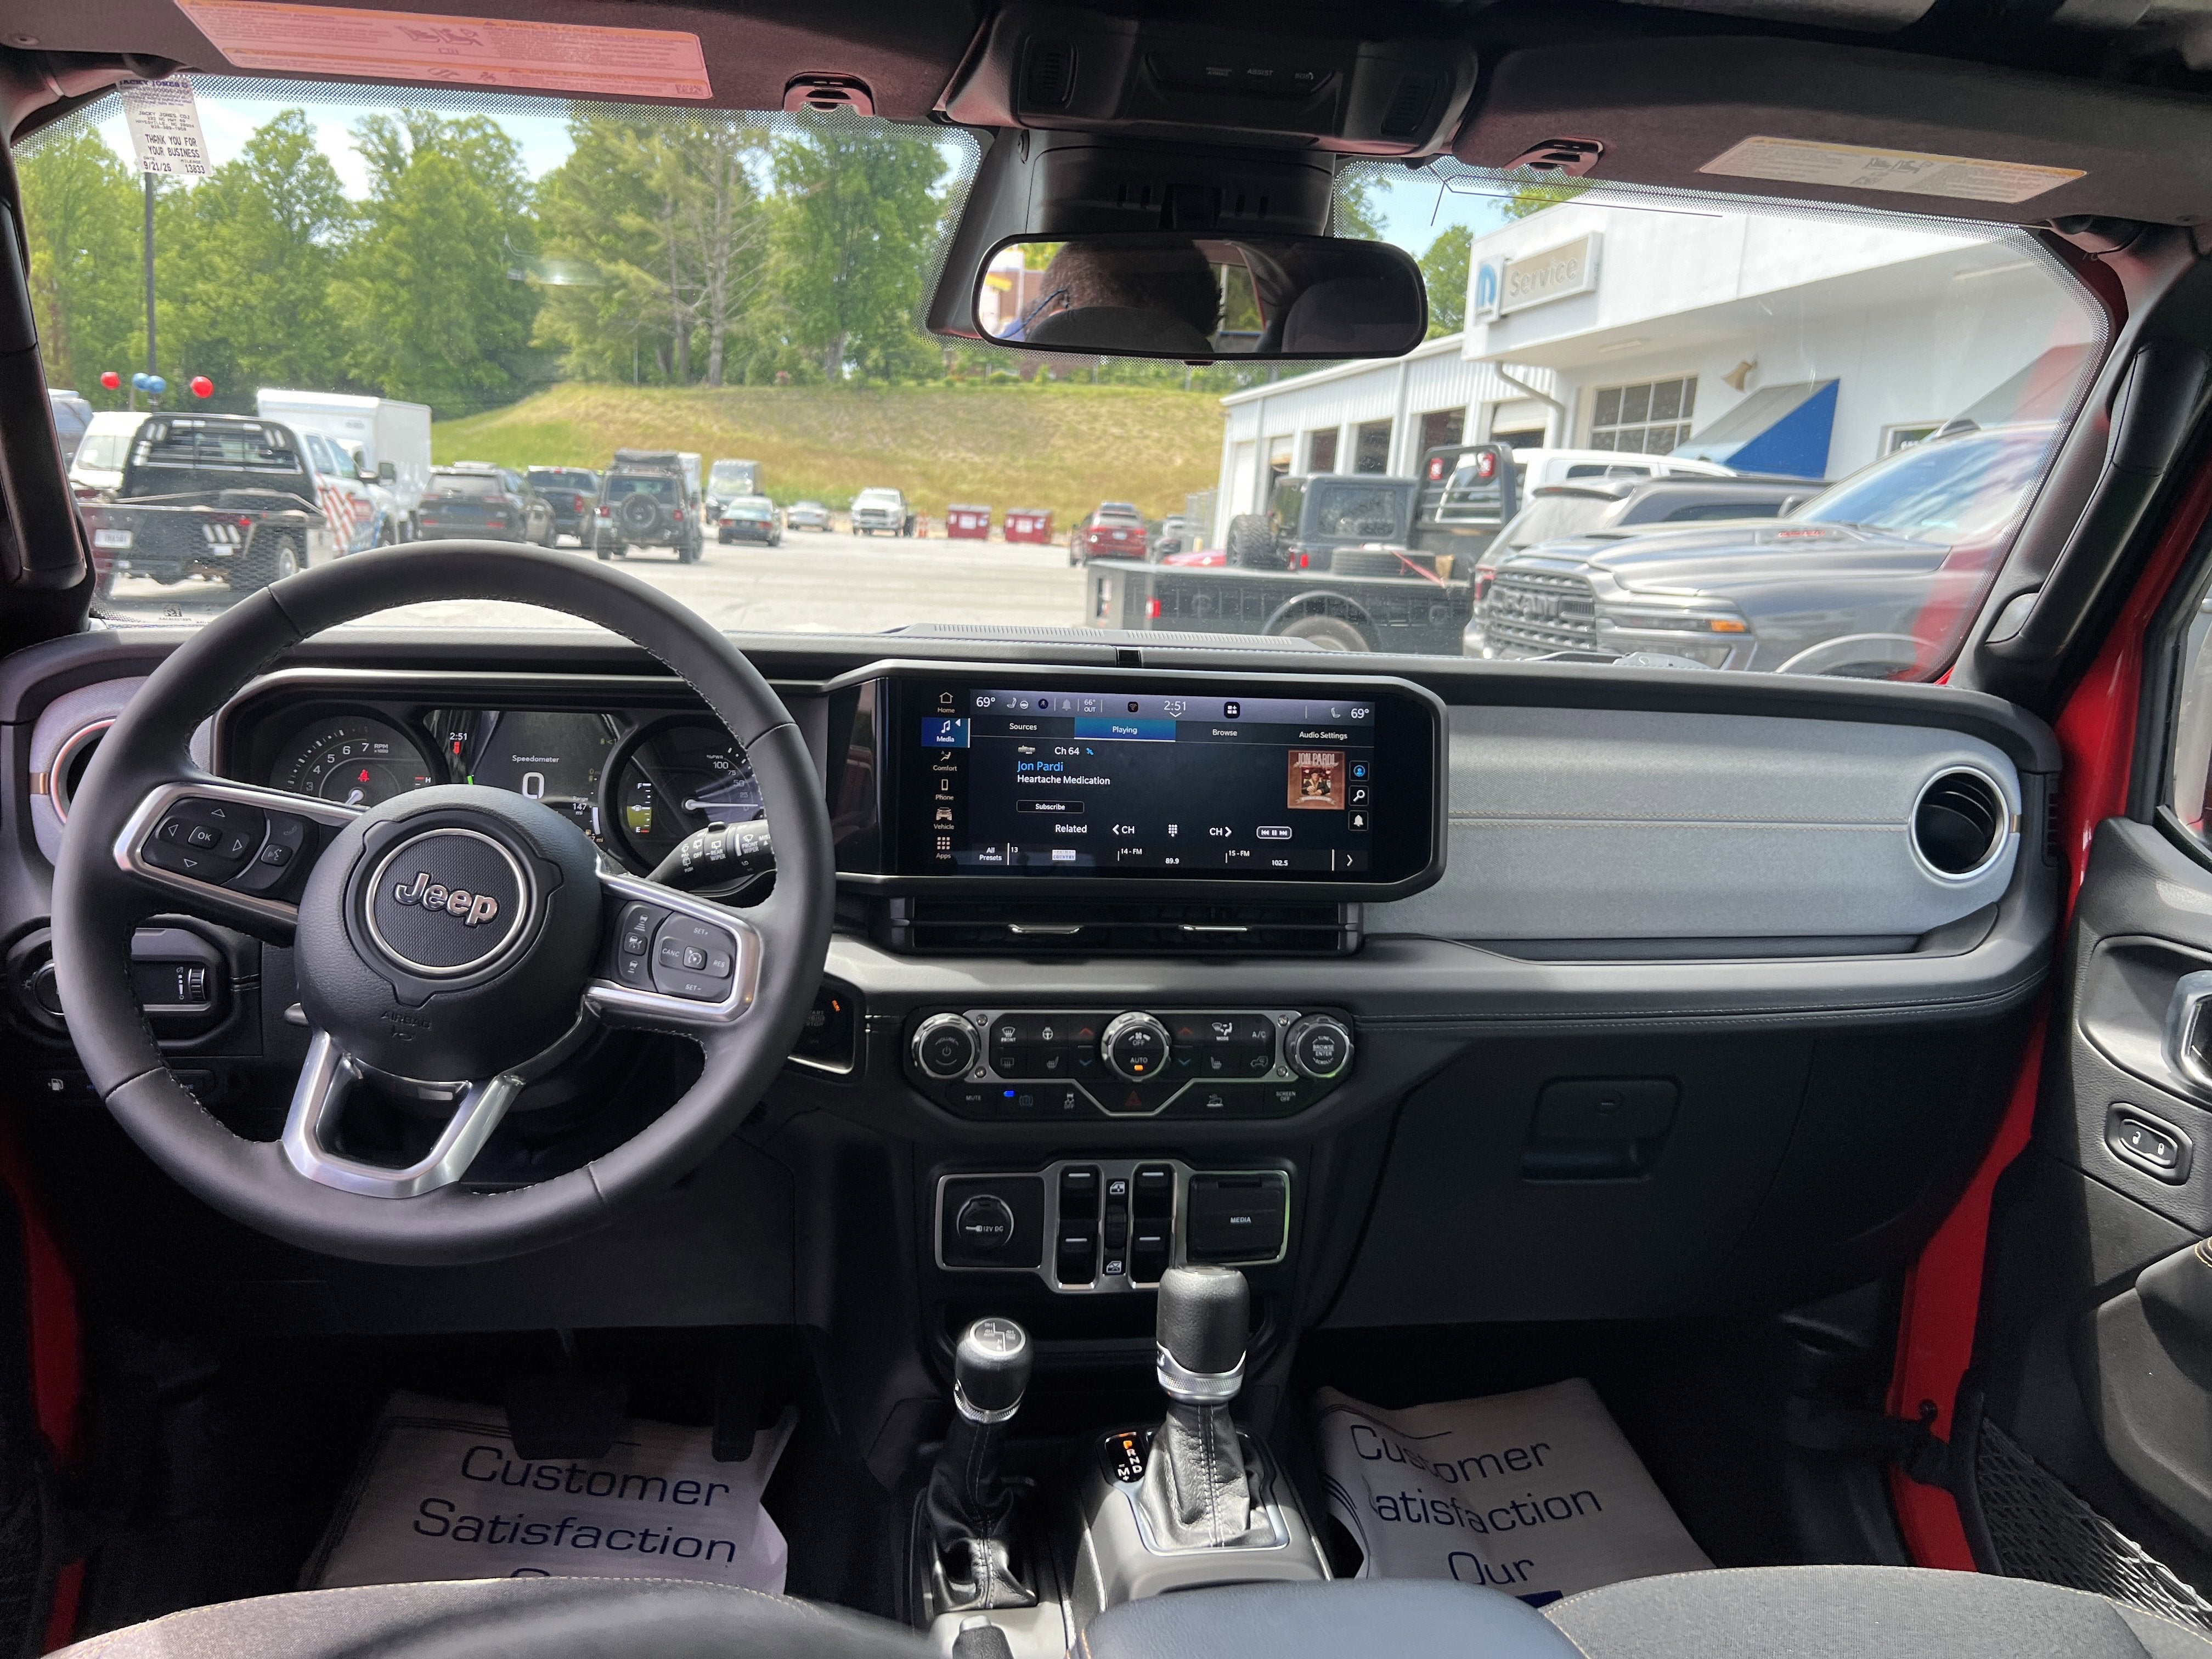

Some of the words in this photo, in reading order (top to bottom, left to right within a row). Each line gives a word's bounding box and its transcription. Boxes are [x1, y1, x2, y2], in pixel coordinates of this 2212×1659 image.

[145, 134, 166, 144] THANK
[168, 136, 182, 145] YOU
[184, 137, 198, 146] FOR
[148, 145, 165, 156] YOUR
[167, 147, 200, 158] BUSINESS
[185, 164, 205, 174] 13833
[1509, 257, 1578, 298] Service
[1164, 701, 1187, 711] 2:51
[1009, 723, 1037, 731] Sources
[1112, 726, 1138, 735] Playing
[450, 732, 467, 741] 2:51
[1320, 732, 1348, 740] Settings
[343, 746, 351, 755] 6
[362, 743, 369, 752] 7
[1054, 747, 1067, 755] Ch
[1068, 747, 1080, 755] 64
[327, 754, 335, 763] 5
[512, 754, 560, 764] Speedometer
[313, 765, 321, 774] 4
[713, 761, 729, 769] 100
[1017, 761, 1034, 772] Jon
[1037, 761, 1064, 772] Pardi
[1017, 774, 1061, 784] Heartache
[1063, 775, 1110, 785] Medication
[306, 782, 314, 792] 3
[522, 772, 545, 799] 0
[1055, 824, 1087, 833] Related
[1121, 826, 1135, 834] CH
[1209, 827, 1223, 836] CH
[198, 832, 212, 842] OK
[394, 872, 498, 927] Jeep
[662, 947, 680, 957] CANC
[713, 960, 725, 968] RES
[381, 1010, 432, 1029] AIRBAG
[1230, 1216, 1251, 1224] MEDIA
[1126, 1448, 1136, 1457] R
[1350, 1424, 1552, 1483] Customer
[1129, 1456, 1140, 1465] N
[1118, 1467, 1130, 1477] M
[1132, 1465, 1142, 1474] D
[461, 1445, 730, 1506] Customer
[1363, 1472, 1603, 1534] atisfaction
[413, 1497, 737, 1563] Satisfaction
[1448, 1551, 1534, 1585] Our
